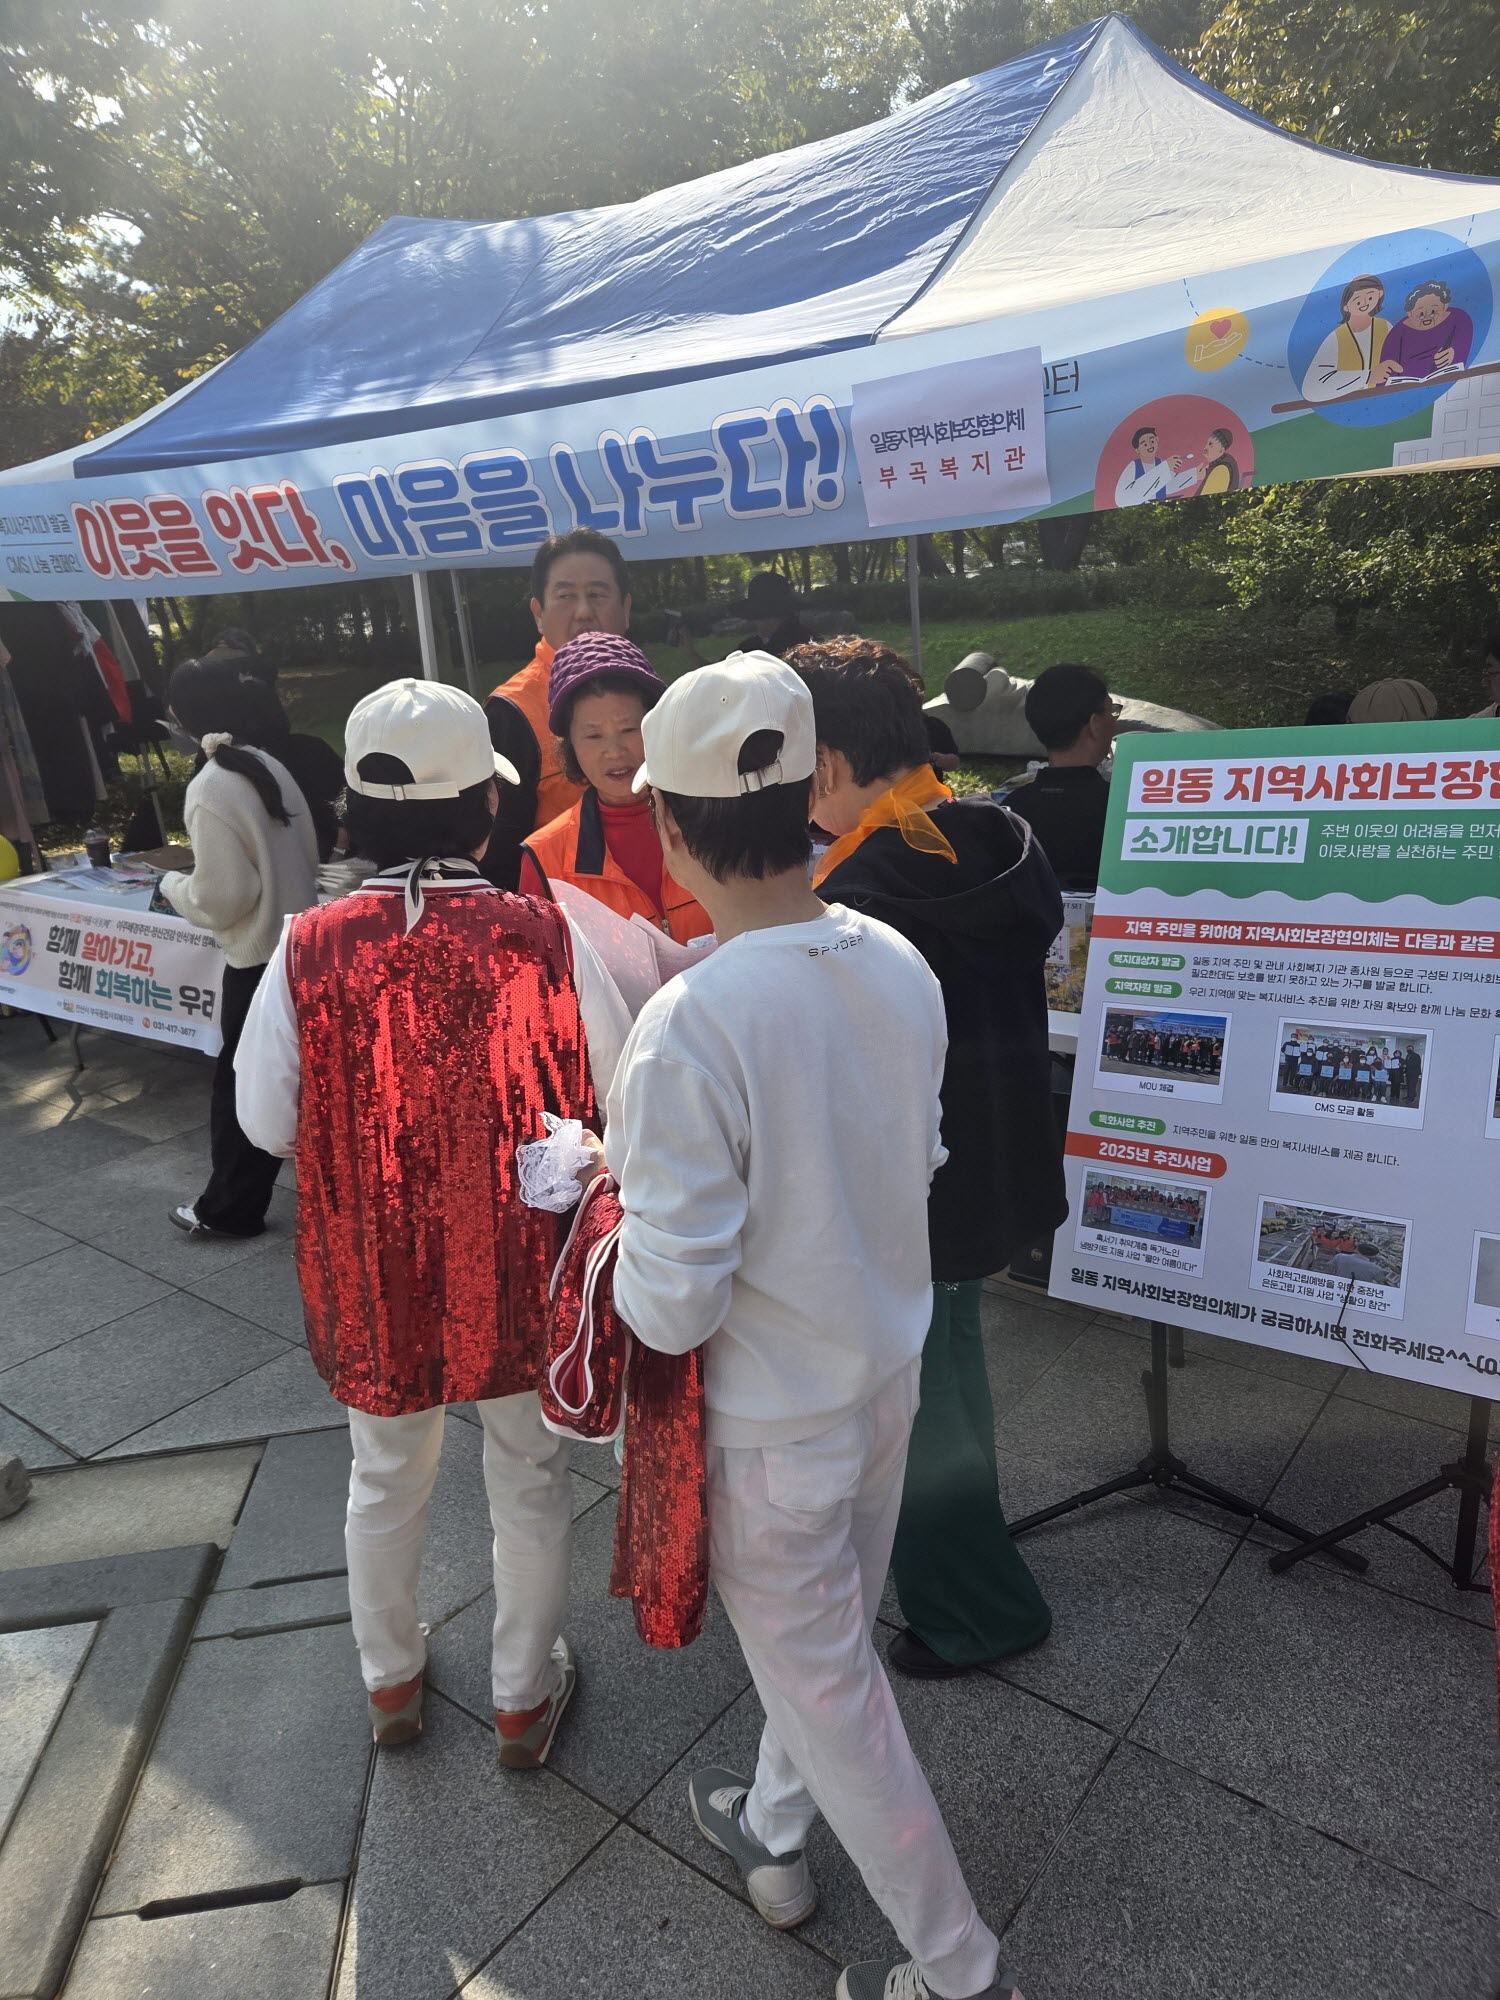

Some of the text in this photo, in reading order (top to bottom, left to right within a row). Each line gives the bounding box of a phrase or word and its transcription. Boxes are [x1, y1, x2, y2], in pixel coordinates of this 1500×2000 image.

[1043, 360, 1080, 398] 터
[870, 408, 1025, 454] 일동지역사회보장협의체
[72, 399, 843, 578] 이웃을 잇다, 마음을 나누다!
[47, 513, 71, 534] 발굴
[6, 553, 83, 574] CMS 나눔 캠페인
[1140, 759, 1500, 804] 일동 지역사회보장
[1130, 825, 1298, 856] 소개합니다!
[1321, 824, 1350, 838] 주변
[1354, 824, 1398, 838] 이웃의
[1402, 824, 1465, 839] 어려움을
[1319, 844, 1494, 860] 이웃사랑을 실천하는 주민
[808, 934, 864, 957] SPYDER
[1125, 920, 1495, 952] 지역 주민을 위하여 지역사회보장협의체는 다음과 같은
[46, 925, 155, 977] 함께 알아가고,
[1113, 954, 1181, 968] 복지대상자 발굴
[1191, 968, 1433, 994] 필요한데도 보호를 받지 못하고 있는 가구를 발굴 합니다.
[1193, 956, 1210, 967] 일동
[1212, 958, 1231, 968] 지역
[1233, 959, 1251, 969] 주민
[1253, 960, 1263, 970] 및
[1265, 960, 1284, 971] 관내
[1286, 962, 1325, 974] 사회복지
[1327, 964, 1347, 975] 기관
[1350, 965, 1380, 977] 종사원
[1383, 967, 1414, 979] 등으로
[1417, 969, 1449, 981] 구성된
[58, 960, 92, 994] 함께
[95, 967, 173, 1011] 회복하는
[1114, 981, 1173, 994] 지역자원 발굴
[1188, 987, 1206, 997] 우리
[1208, 988, 1236, 1000] 지역에
[1258, 992, 1306, 1005] 복지서비스
[1308, 995, 1338, 1008] 추진을
[1340, 997, 1360, 1009] 위한
[1363, 999, 1384, 1011] 자원
[1386, 1001, 1417, 1013] 확보와
[1420, 1003, 1441, 1015] 함께
[1444, 1005, 1466, 1018] 나눔
[1469, 1007, 1492, 1019] 문화
[1139, 1081, 1157, 1091] MOU
[1314, 1102, 1375, 1118] CMS 모금 활동
[1137, 1119, 1157, 1131] 추진
[1098, 1142, 1212, 1172] 2025년 추진사업
[1173, 1124, 1400, 1166] 지역주민을 위한 일동 만의 복지서비스를 제공 합니다.
[1109, 1246, 1125, 1258] 지원
[1126, 1249, 1141, 1261] 사업
[1262, 1278, 1296, 1293] 은둔고립
[1297, 1285, 1315, 1298] 지원
[1316, 1289, 1334, 1301] 사업
[1267, 1268, 1335, 1289] 사회적고립예방을
[1357, 1285, 1384, 1299] 중장년
[1071, 1267, 1099, 1287] 일동
[1102, 1274, 1257, 1322] 지역사회보장협의체가
[1261, 1309, 1347, 1342] 궁금하시면
